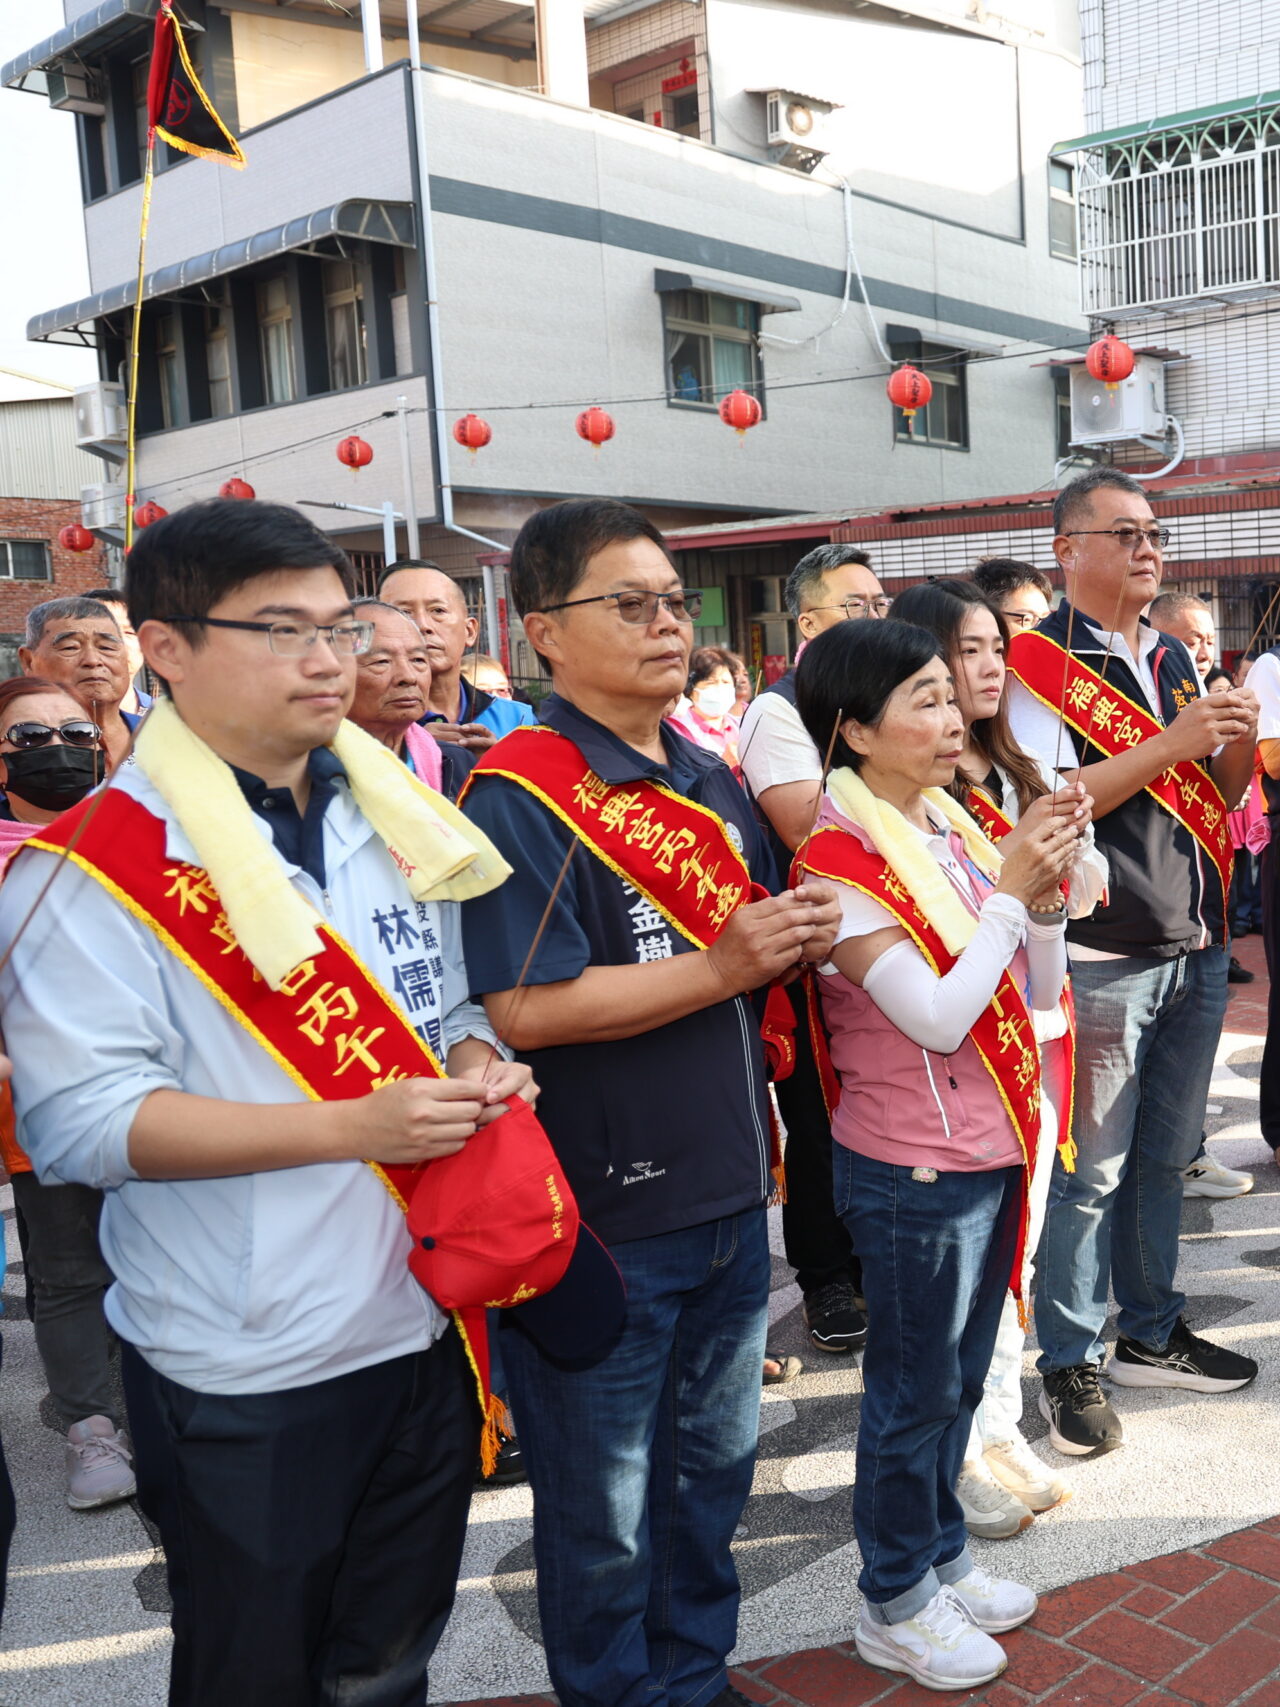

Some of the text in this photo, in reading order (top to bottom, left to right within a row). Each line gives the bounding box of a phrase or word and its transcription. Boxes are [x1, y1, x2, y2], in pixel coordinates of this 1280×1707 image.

[1066, 676, 1143, 747] 福興宮
[621, 872, 674, 964] 金樹
[163, 862, 425, 1092] 福丙午
